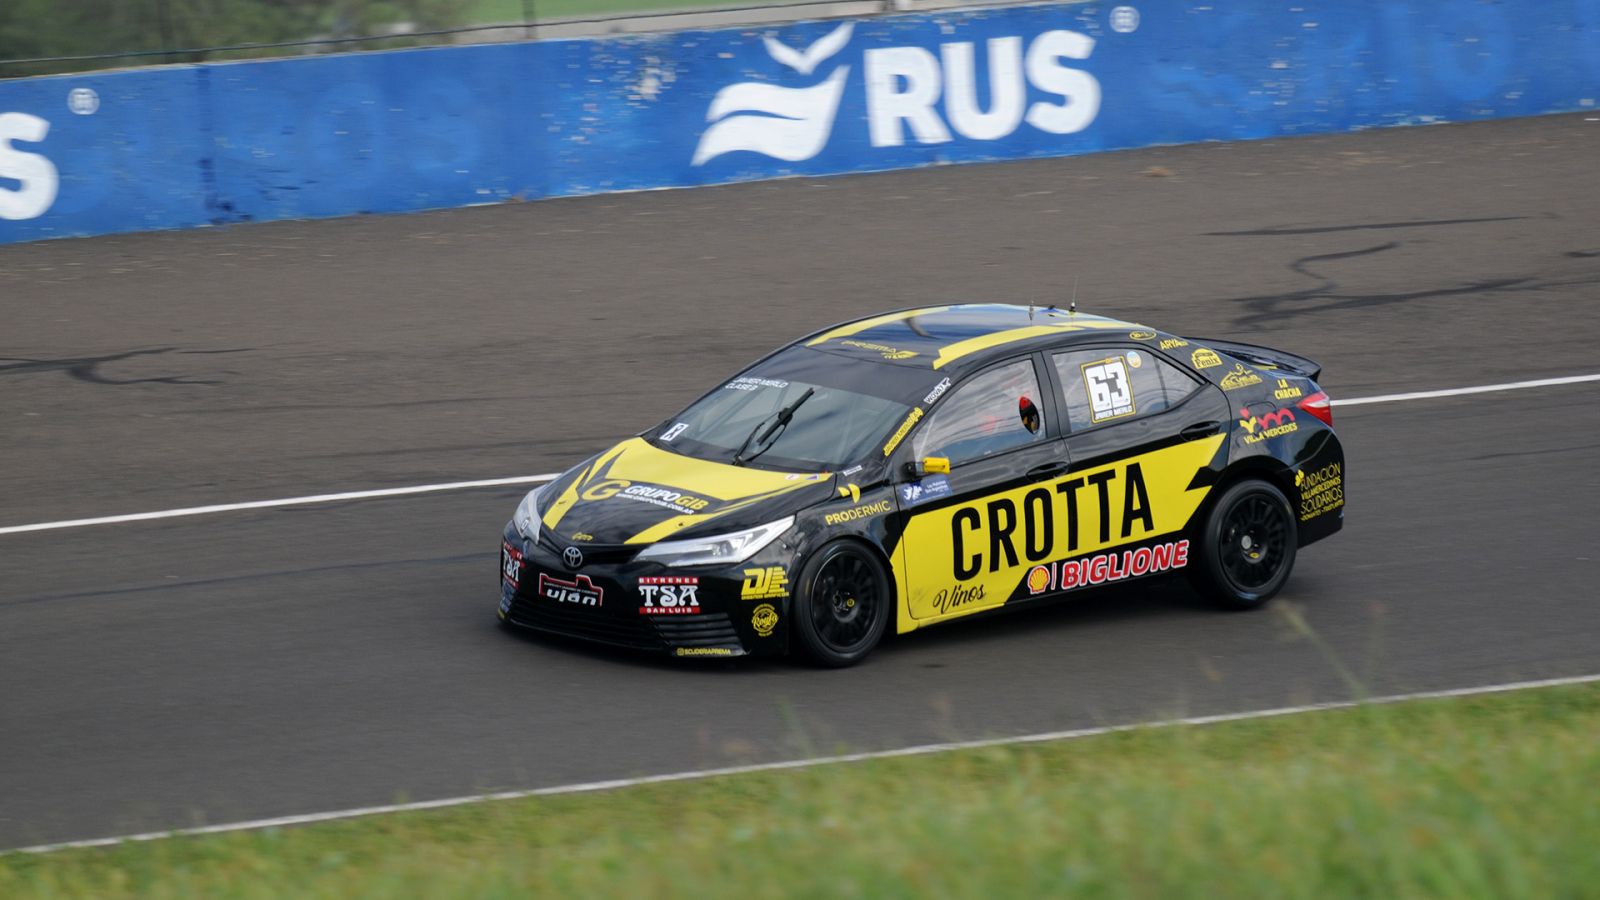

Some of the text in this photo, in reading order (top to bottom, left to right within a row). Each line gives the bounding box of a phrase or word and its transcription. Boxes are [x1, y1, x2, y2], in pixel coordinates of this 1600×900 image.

[864, 29, 1101, 147] RUS
[1085, 361, 1131, 412] 63
[1274, 387, 1302, 399] CHACHA
[1277, 378, 1288, 388] LA
[1264, 422, 1298, 438] MERCEDES
[825, 500, 891, 525] PRODERMIC
[1300, 485, 1343, 514] SOLIDARIOS
[952, 462, 1154, 582] CROTTA
[1061, 540, 1189, 590] BIGLIONE
[638, 585, 700, 607] TSA
[932, 583, 986, 614] Vinos
